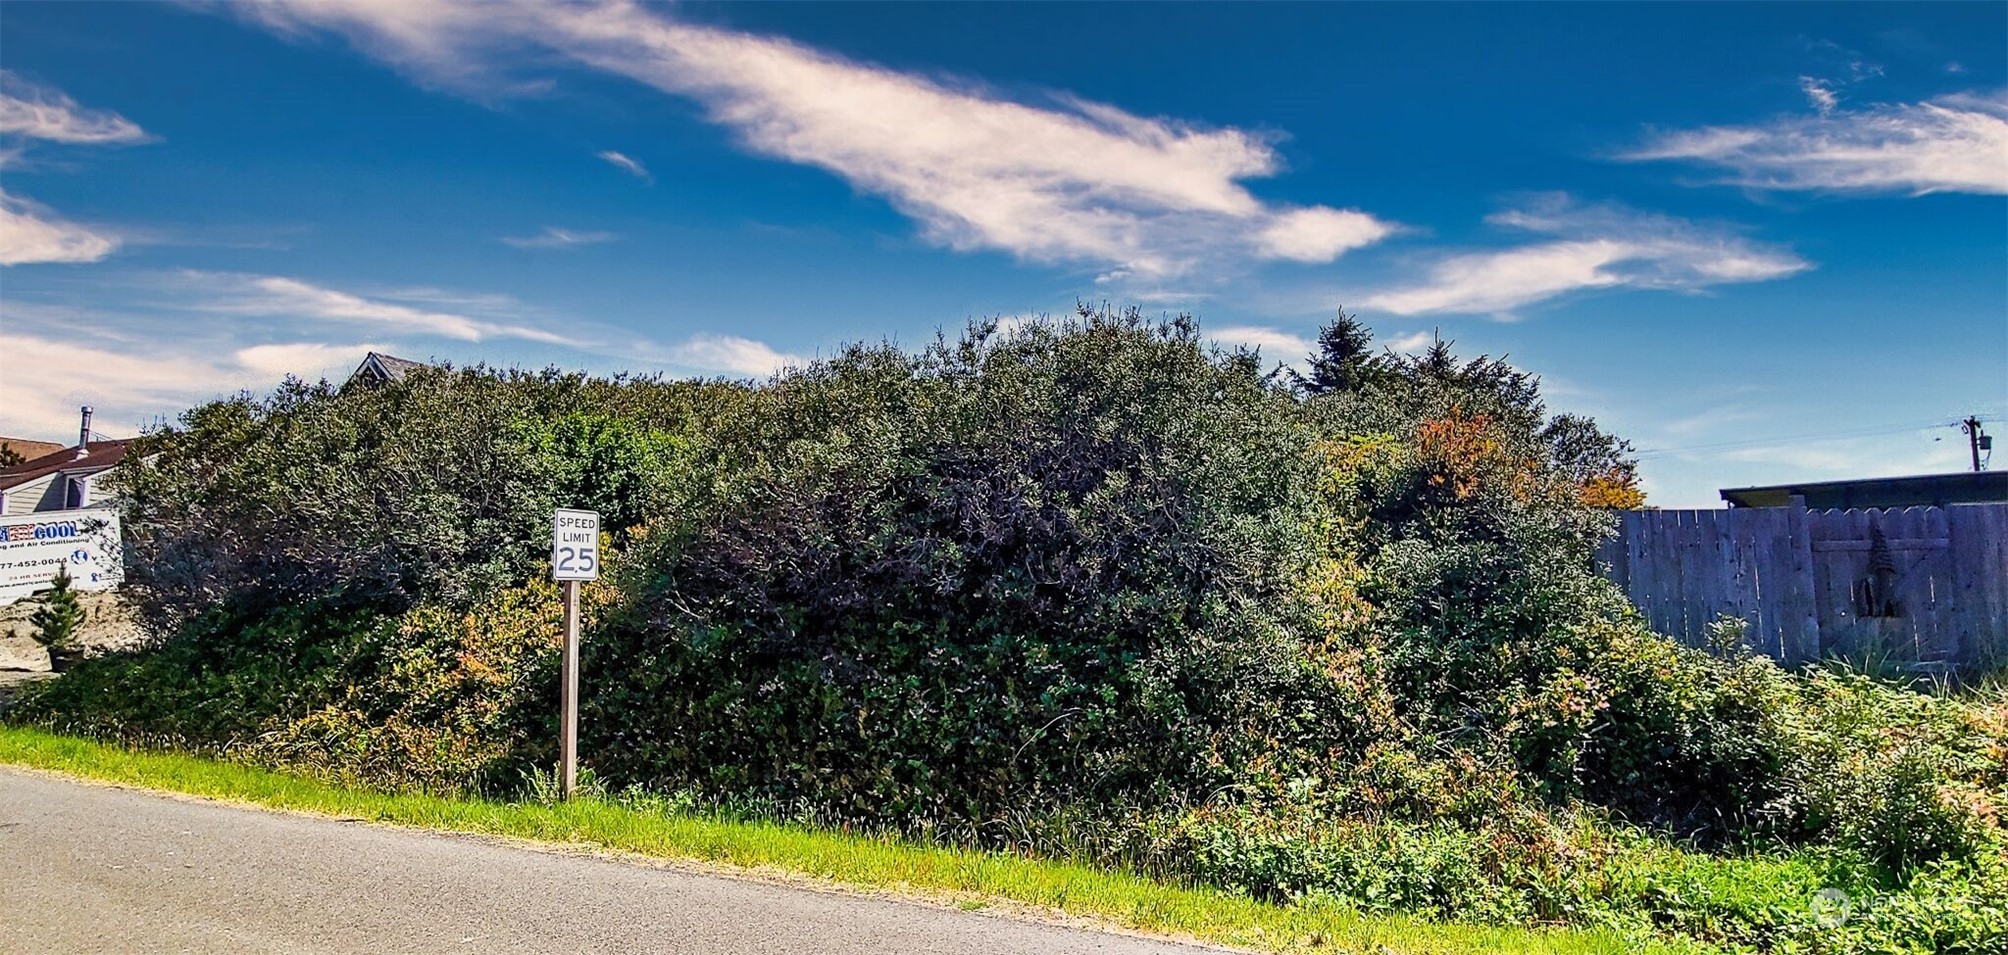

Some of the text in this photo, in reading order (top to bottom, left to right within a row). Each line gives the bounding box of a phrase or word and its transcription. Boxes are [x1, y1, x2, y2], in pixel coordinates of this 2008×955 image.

[560, 518, 595, 529] SPEED
[40, 538, 90, 546] Conditioning
[563, 532, 591, 543] LIMIT
[559, 547, 594, 572] 25
